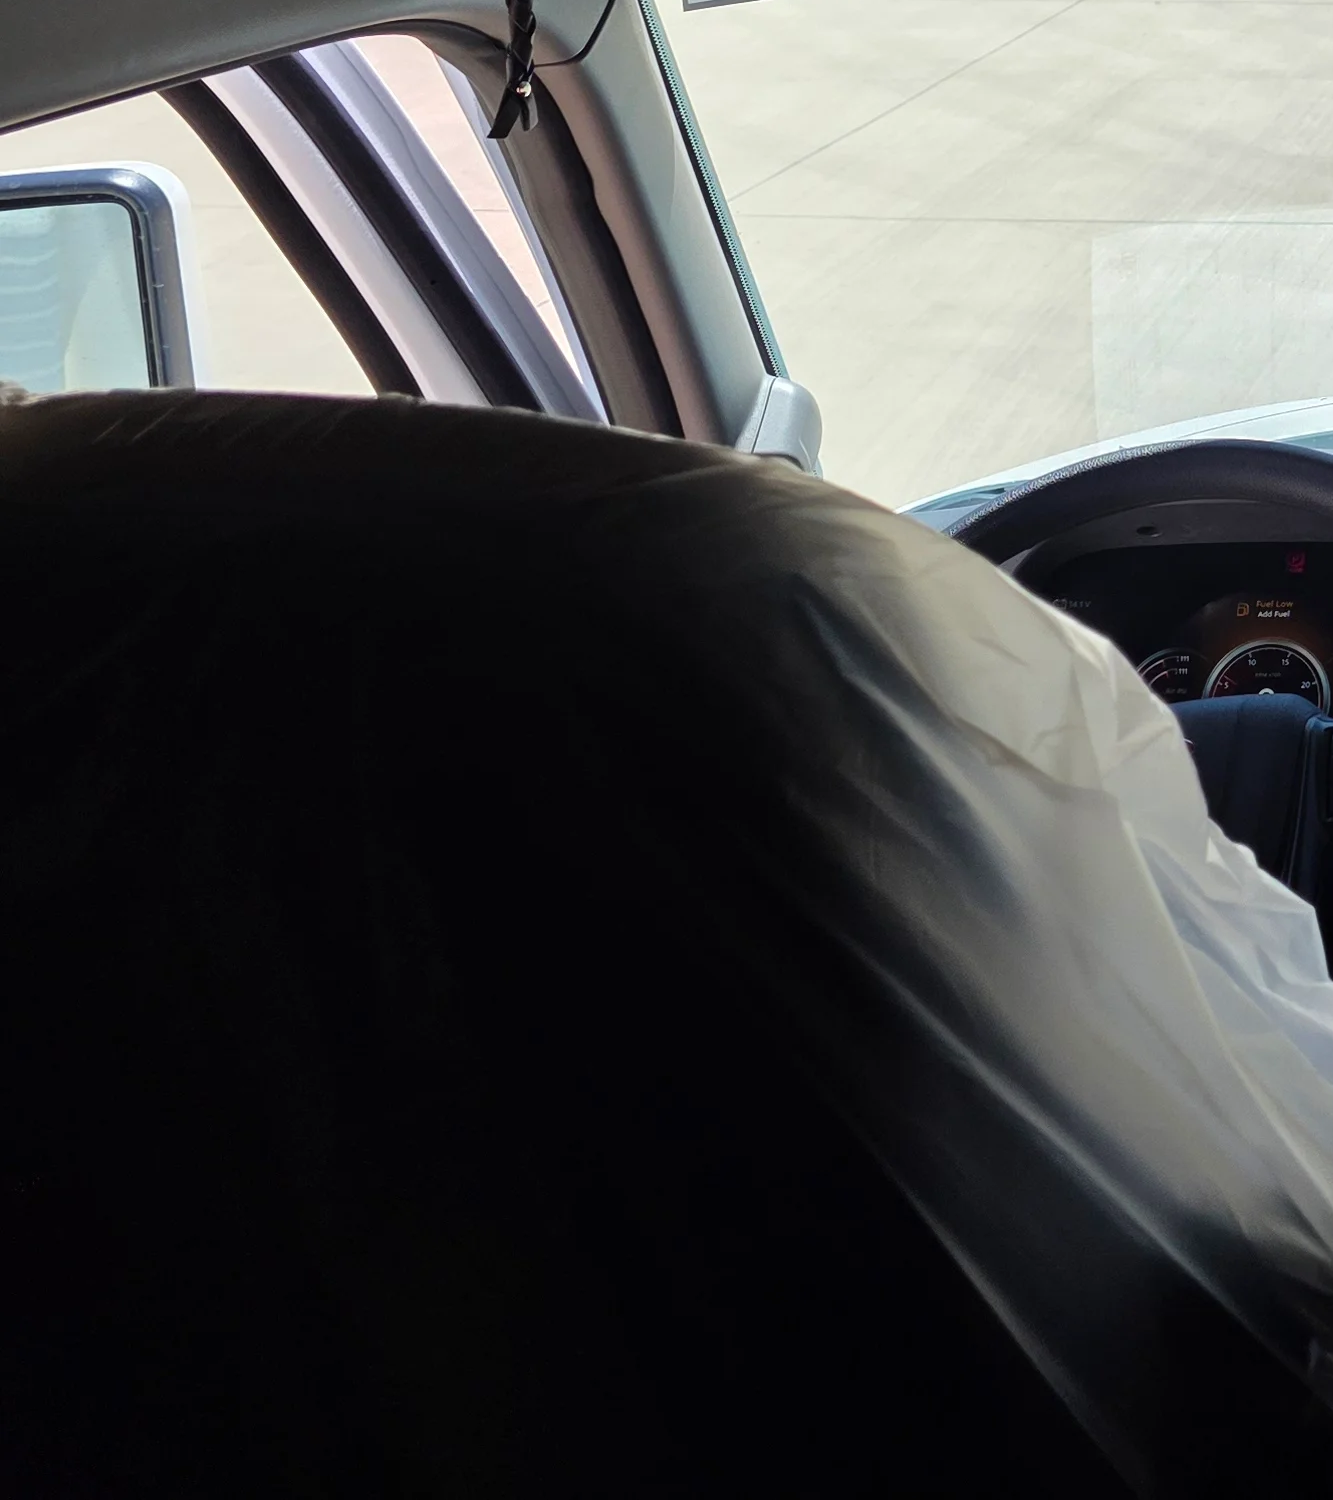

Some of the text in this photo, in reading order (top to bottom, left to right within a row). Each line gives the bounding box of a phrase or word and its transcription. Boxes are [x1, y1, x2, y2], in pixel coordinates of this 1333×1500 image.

[1255, 599, 1294, 609] Fuel Low
[1256, 609, 1291, 618] Add Fuel
[1248, 658, 1257, 666] 10
[1281, 658, 1291, 666] 15
[1300, 681, 1311, 689] 20
